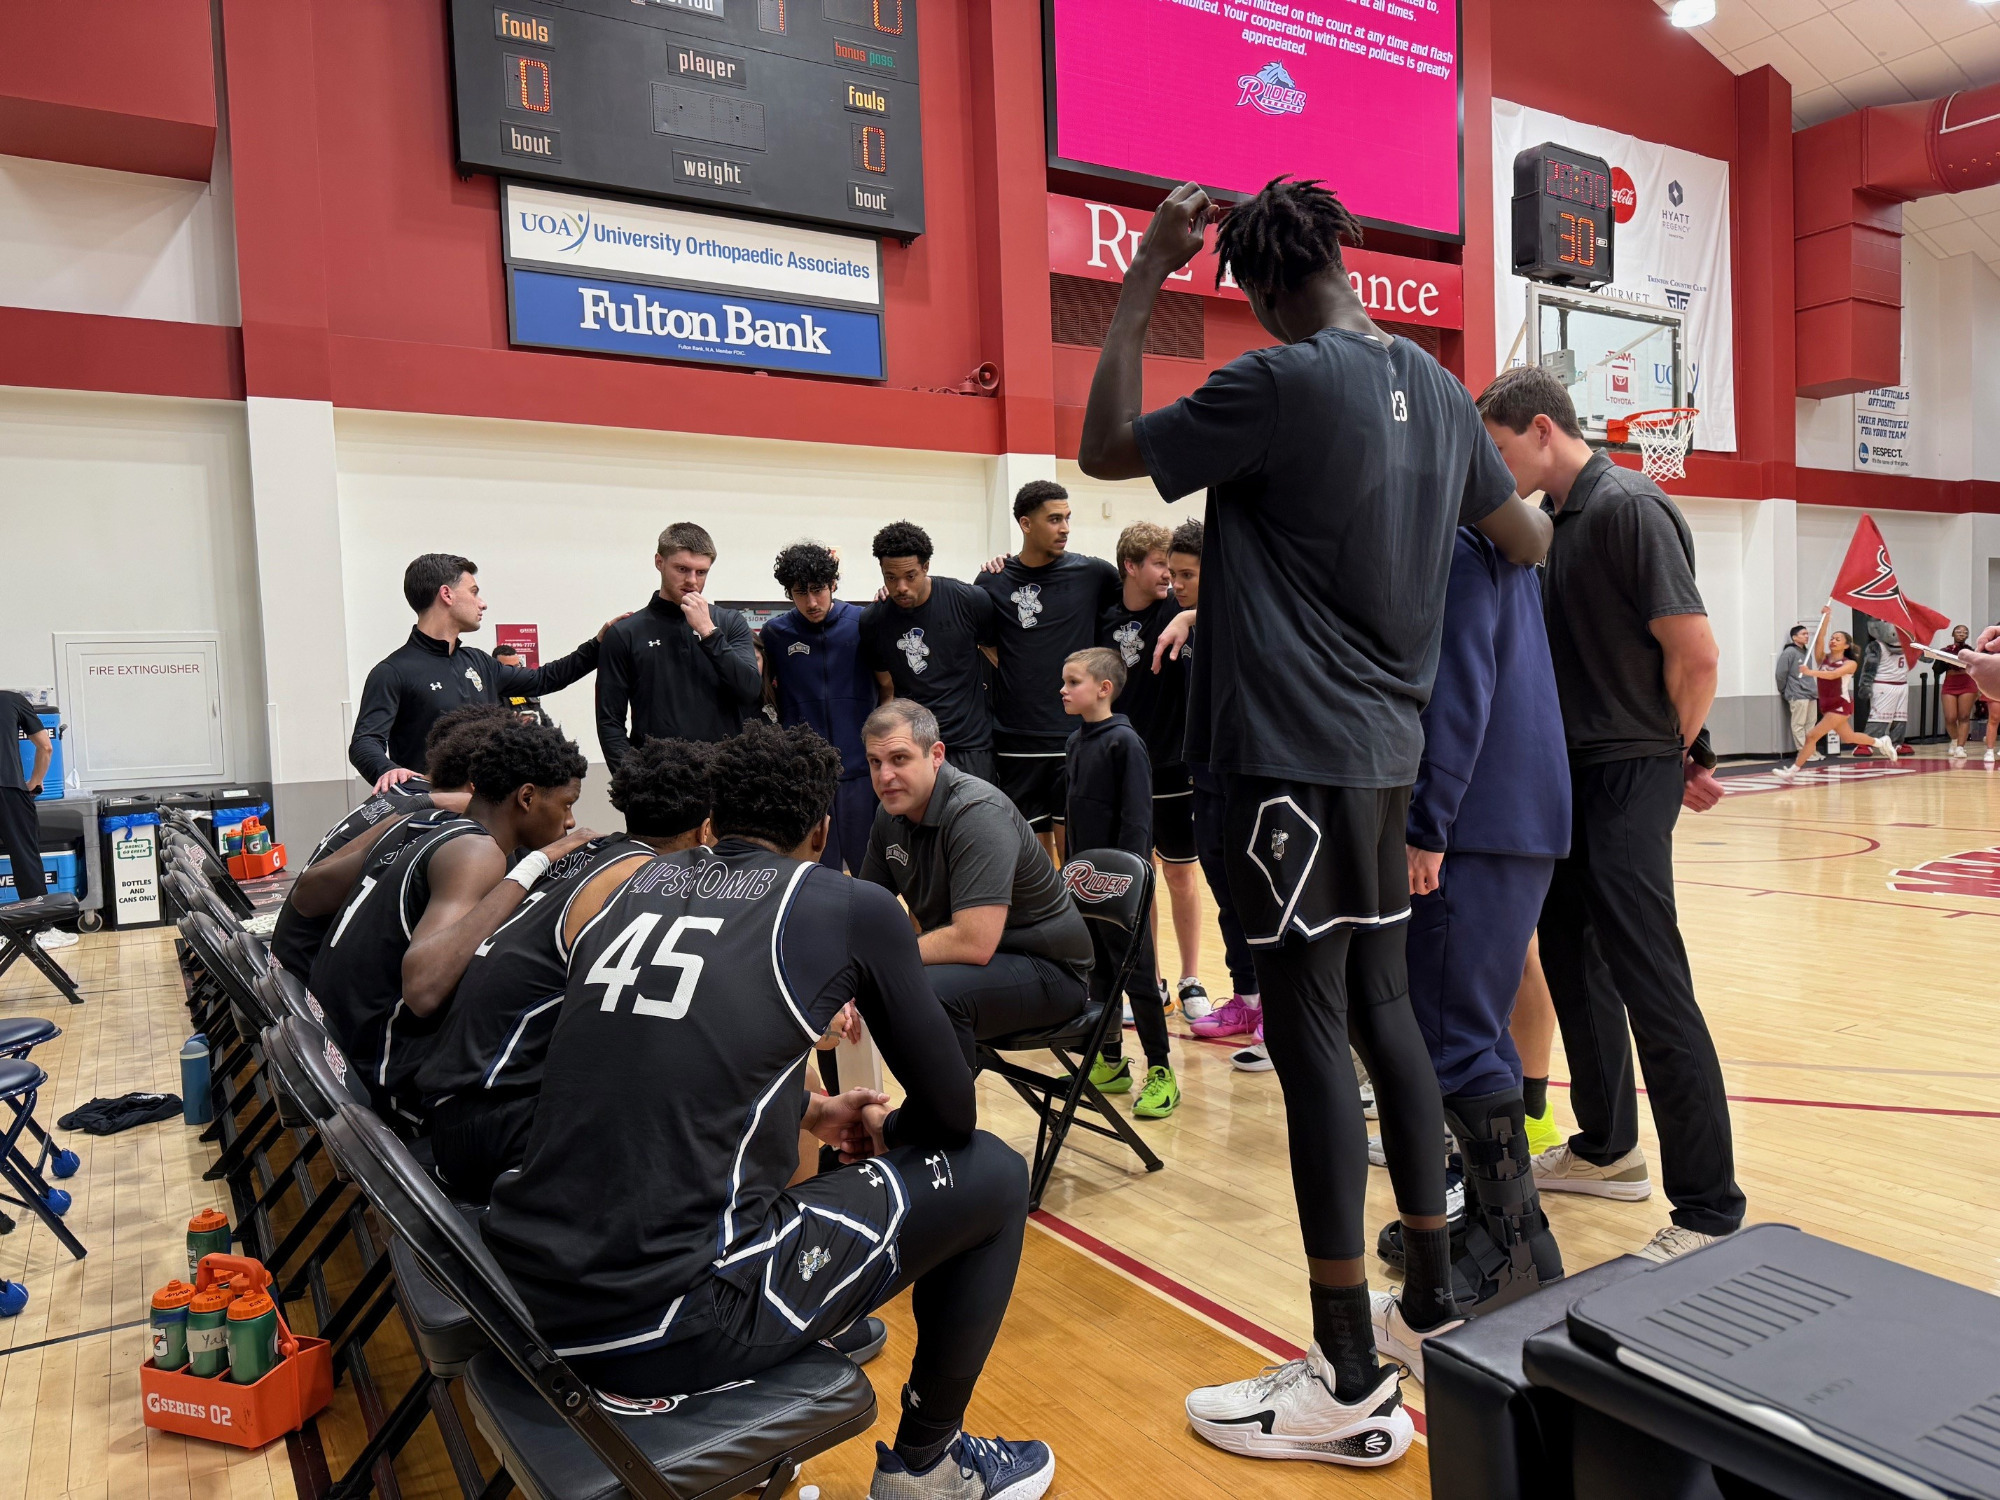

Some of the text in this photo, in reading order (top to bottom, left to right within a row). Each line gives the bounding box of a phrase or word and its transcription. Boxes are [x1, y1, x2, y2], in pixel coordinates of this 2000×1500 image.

[1387, 3, 1417, 21] times.
[501, 17, 549, 43] fouls
[1223, 3, 1249, 22] Your
[1251, 13, 1312, 40] cooperation
[1314, 31, 1337, 47] with
[1339, 38, 1366, 55] these
[1368, 47, 1404, 66] policies
[1407, 56, 1415, 69] is
[1417, 61, 1450, 80] greatly
[1242, 28, 1307, 56] appreciated.
[1291, 8, 1304, 21] on
[1306, 10, 1324, 26] the
[1326, 18, 1352, 35] court
[1354, 26, 1366, 39] at
[1367, 30, 1385, 45] any
[1387, 35, 1409, 51] time
[1411, 43, 1429, 56] and
[1430, 47, 1453, 64] flash
[679, 50, 736, 80] player
[835, 42, 896, 68] bonus poss.
[519, 58, 550, 113] 0
[848, 86, 886, 112] fouls
[1236, 75, 1306, 115] RIDER
[511, 128, 552, 156] bout
[863, 125, 886, 173] 0
[683, 157, 742, 186] weight
[855, 187, 887, 212] bout
[1661, 209, 1690, 225] HYATT
[1662, 221, 1691, 233] REGENCY
[519, 211, 870, 280] UOA University Orthopaedic Associates
[1560, 212, 1594, 266] 30
[1600, 285, 1650, 304] OURMET
[578, 287, 831, 356] Fulton Bank
[1610, 396, 1632, 406] TOYOTA
[1888, 430, 1907, 440] TEAM
[1872, 446, 1903, 458] RESPECT.
[89, 663, 200, 676] FIRE EXTINGUISHER
[272, 851, 281, 867] G
[121, 879, 152, 888] BOTTLES
[628, 858, 778, 901] LIPSCOMB
[1062, 860, 1133, 903] RIDER
[118, 894, 157, 904] CANS ONLY
[584, 911, 724, 1020] 45
[160, 1399, 206, 1419] SERIES
[210, 1404, 232, 1427] 02
